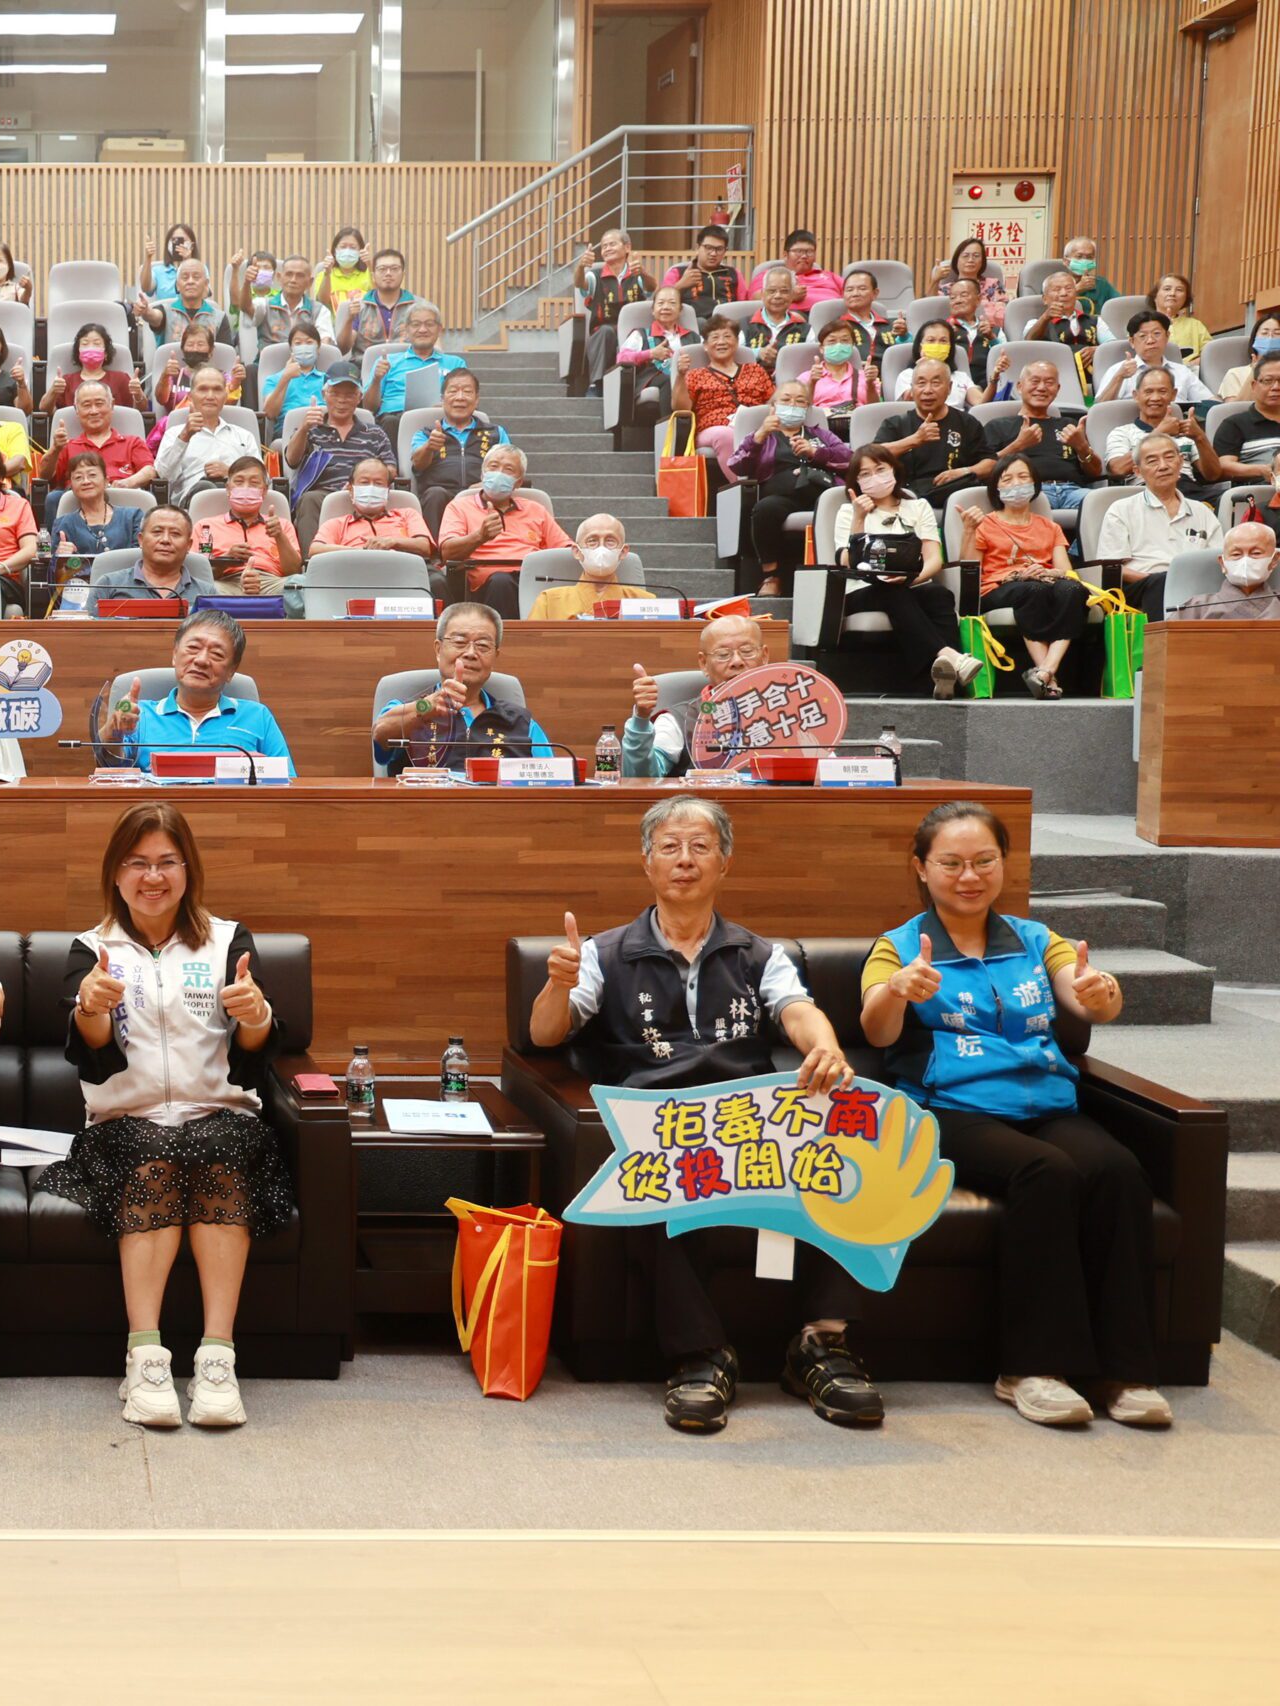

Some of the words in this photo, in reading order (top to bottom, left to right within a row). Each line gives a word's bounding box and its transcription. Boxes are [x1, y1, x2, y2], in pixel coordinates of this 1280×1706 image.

[971, 221, 1024, 242] 消防栓
[710, 671, 816, 730] 雙手合十
[240, 766, 265, 774] 永宮
[132, 964, 145, 1009] 立法委員
[184, 991, 215, 1000] TAIWAN
[183, 1001, 215, 1009] PEOPLE'S
[654, 1086, 880, 1149] 拒毒不南
[619, 1138, 844, 1202] 從投開始
